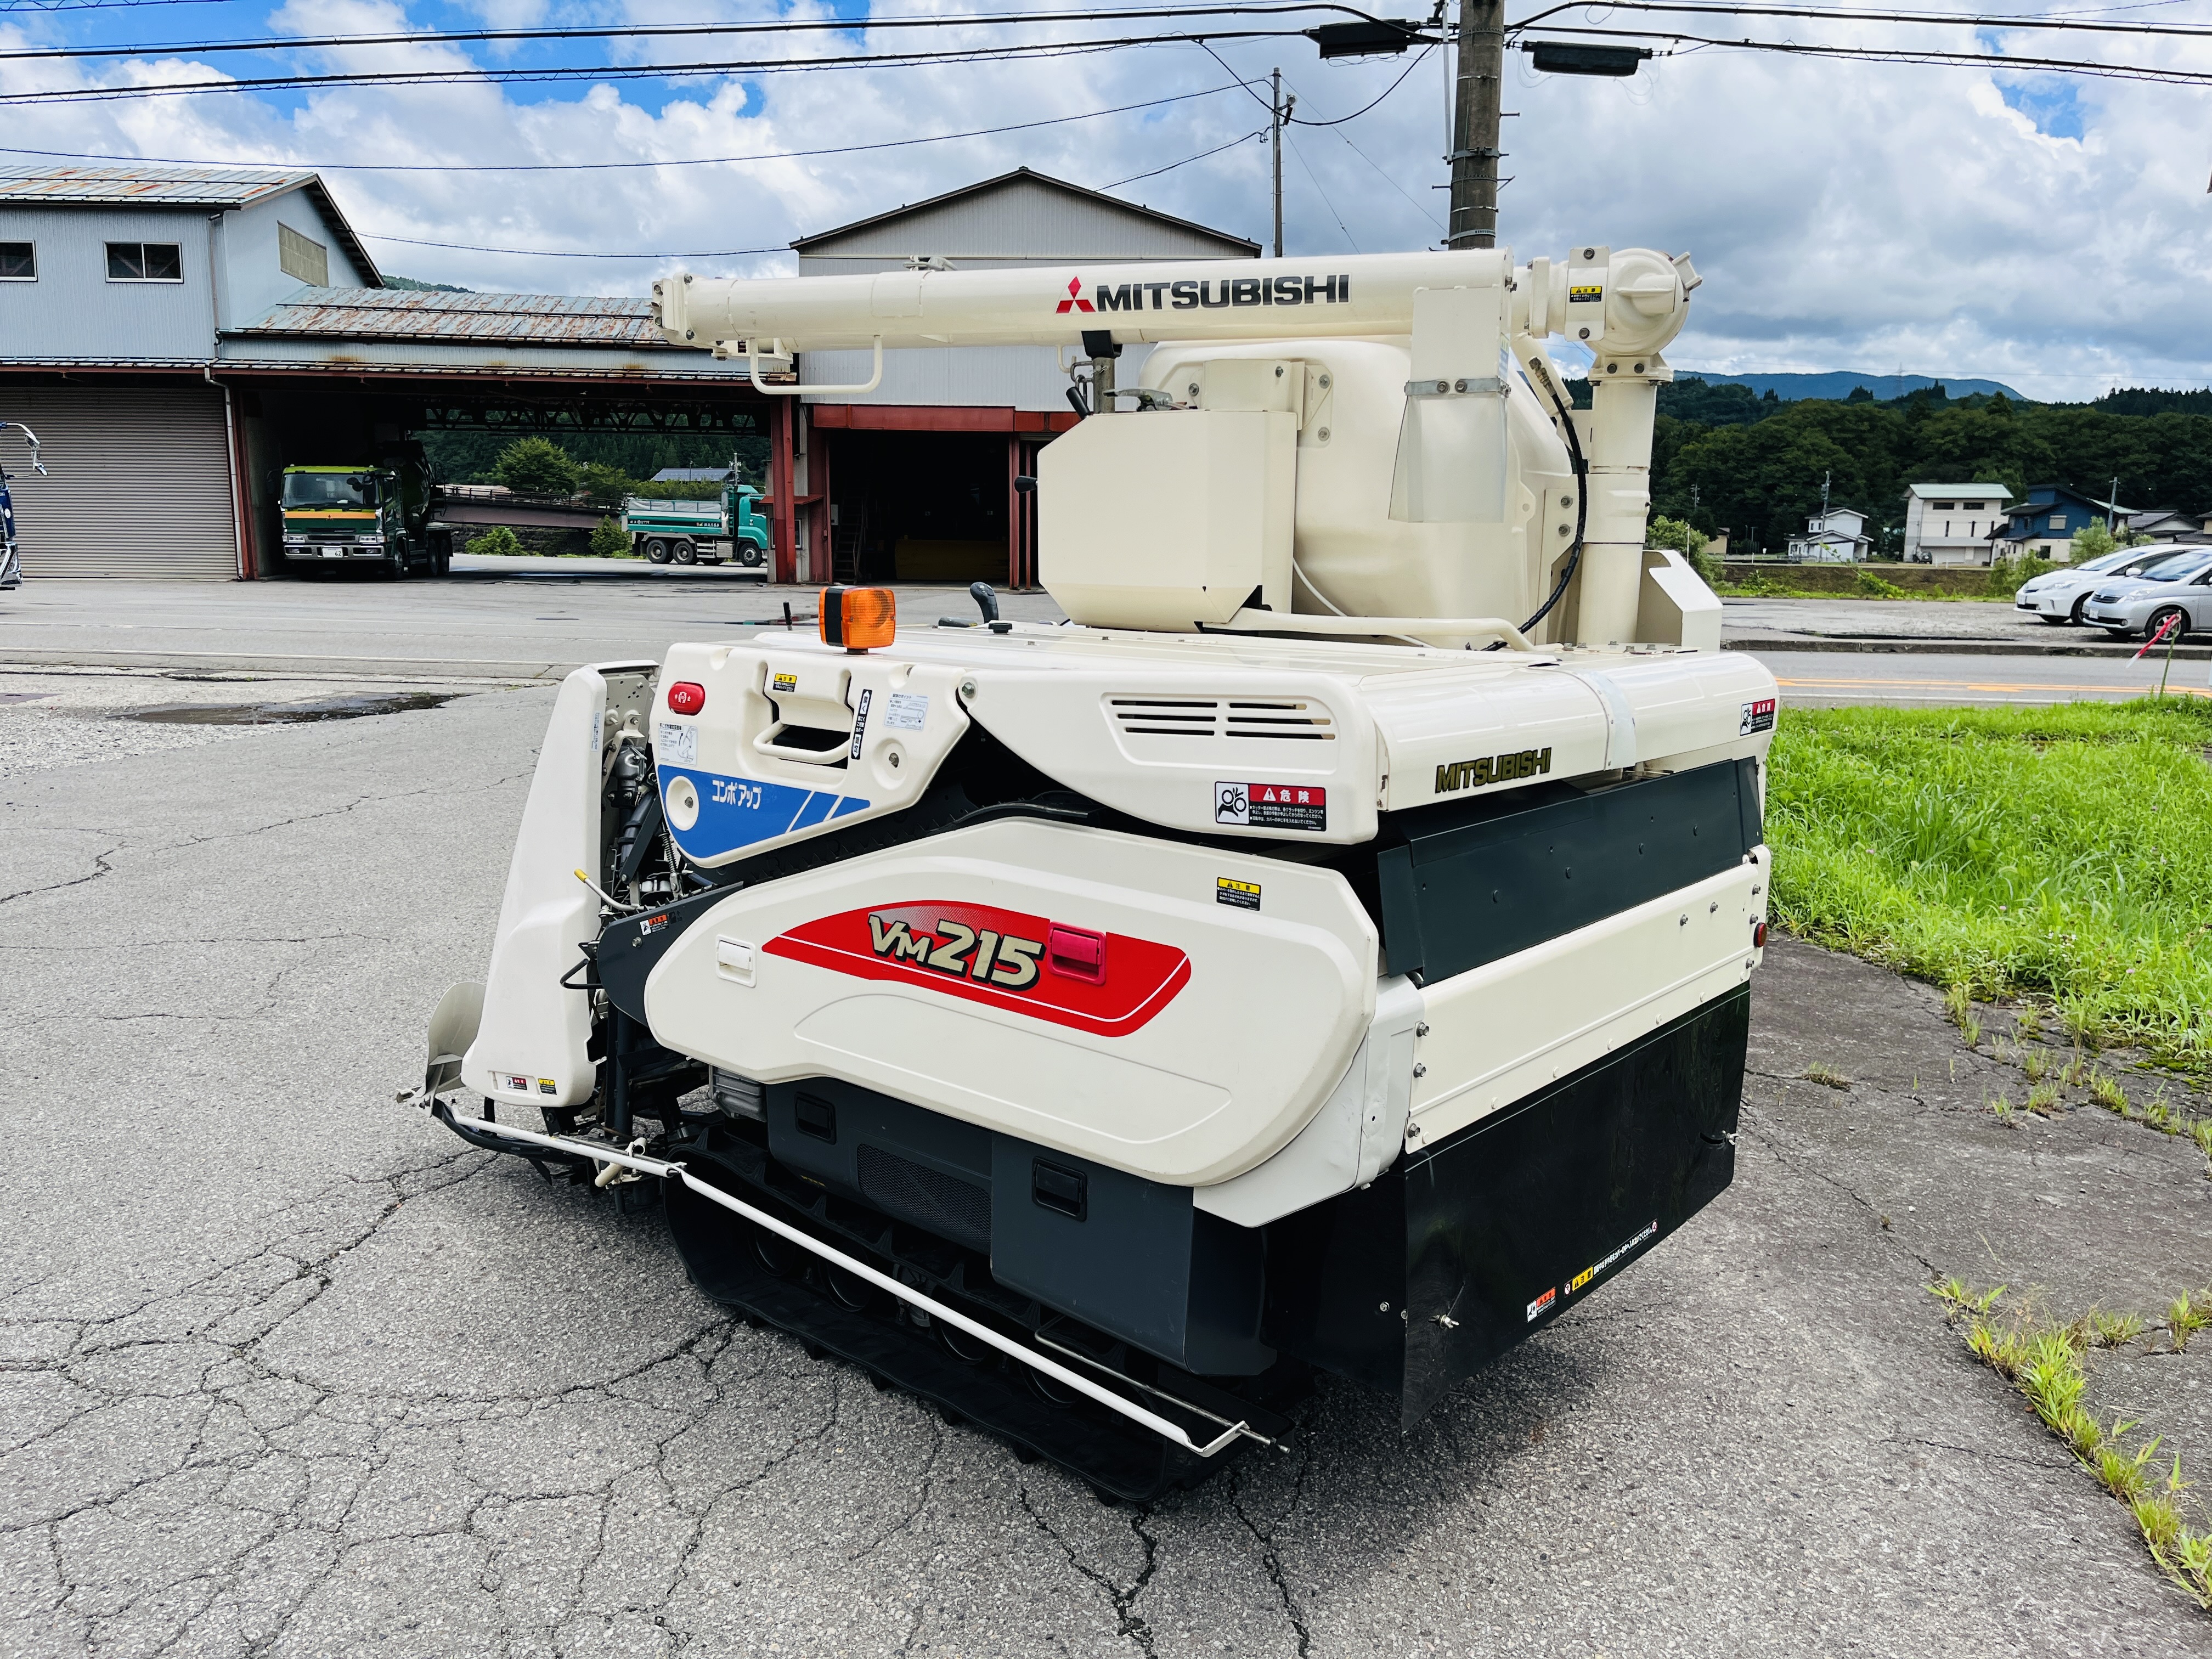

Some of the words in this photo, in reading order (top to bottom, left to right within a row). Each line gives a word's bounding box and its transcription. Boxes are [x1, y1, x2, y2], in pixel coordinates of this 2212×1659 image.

[1097, 274, 1350, 312] MITSUBISHI
[1435, 747, 1552, 794] MITSUBISHI
[712, 779, 762, 810] コンポアップ
[1279, 789, 1310, 804] 危険
[868, 914, 1046, 992] VM215
